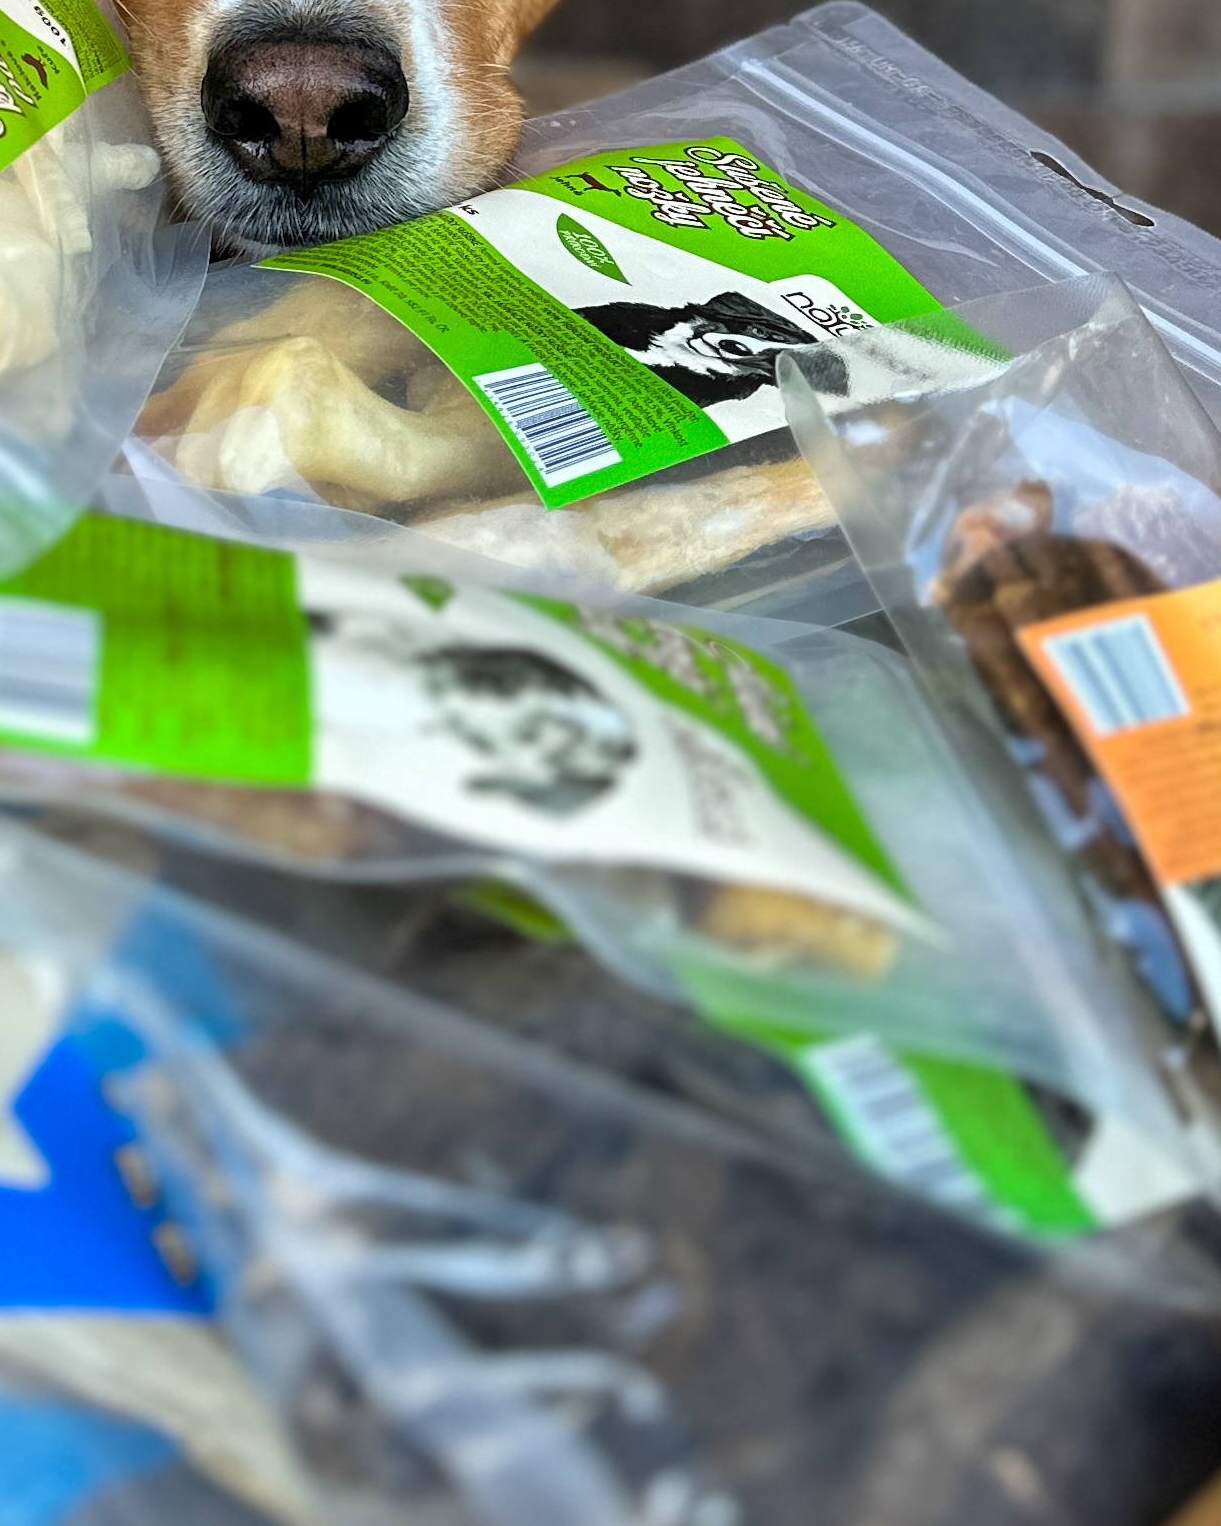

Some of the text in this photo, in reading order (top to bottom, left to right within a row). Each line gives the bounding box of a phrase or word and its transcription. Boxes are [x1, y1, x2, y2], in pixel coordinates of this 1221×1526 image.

[33, 4, 69, 48] 100g
[458, 204, 480, 216] ks
[604, 165, 712, 230] nožky
[629, 156, 796, 242] jehněčí
[684, 146, 837, 231] Sušené
[572, 231, 615, 265] 100%
